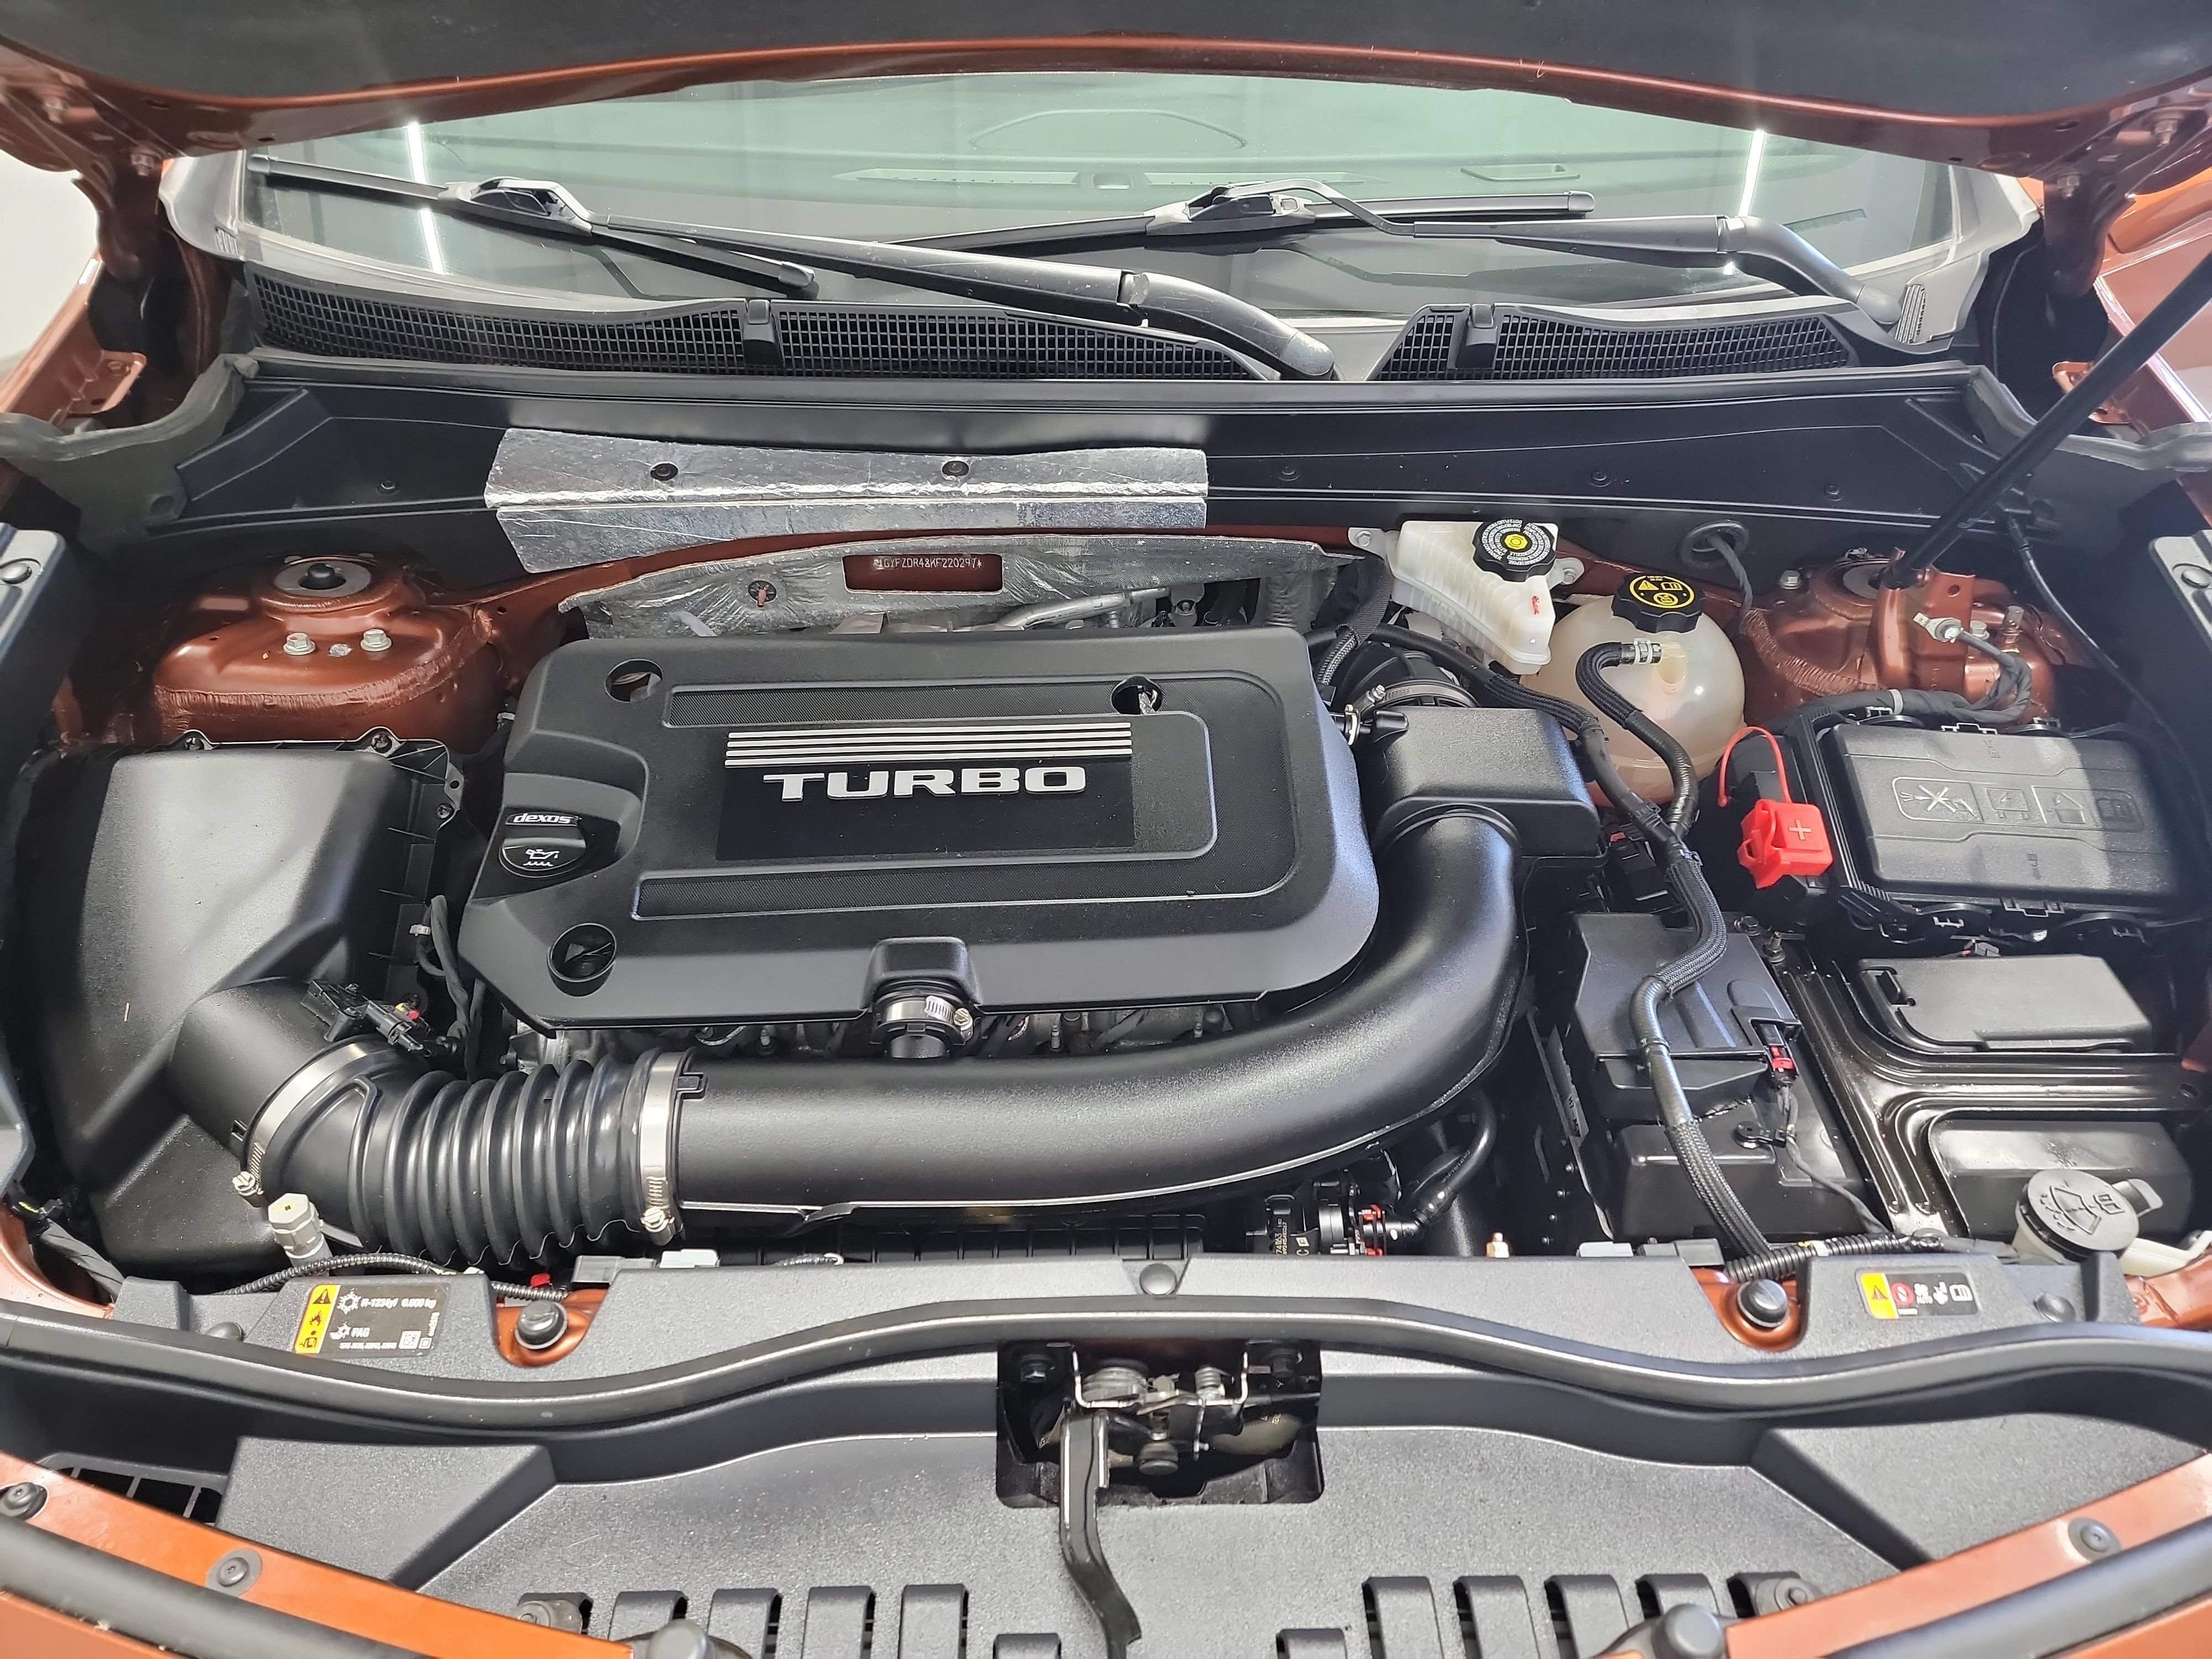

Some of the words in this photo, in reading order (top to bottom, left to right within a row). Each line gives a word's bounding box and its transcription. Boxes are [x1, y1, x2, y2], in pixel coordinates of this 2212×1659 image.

[763, 766, 1087, 801] TURBO
[513, 813, 575, 824] dexos
[360, 1298, 398, 1309] R-1234yf
[1916, 1296, 1933, 1304] AUTO
[351, 1327, 370, 1337] PAG
